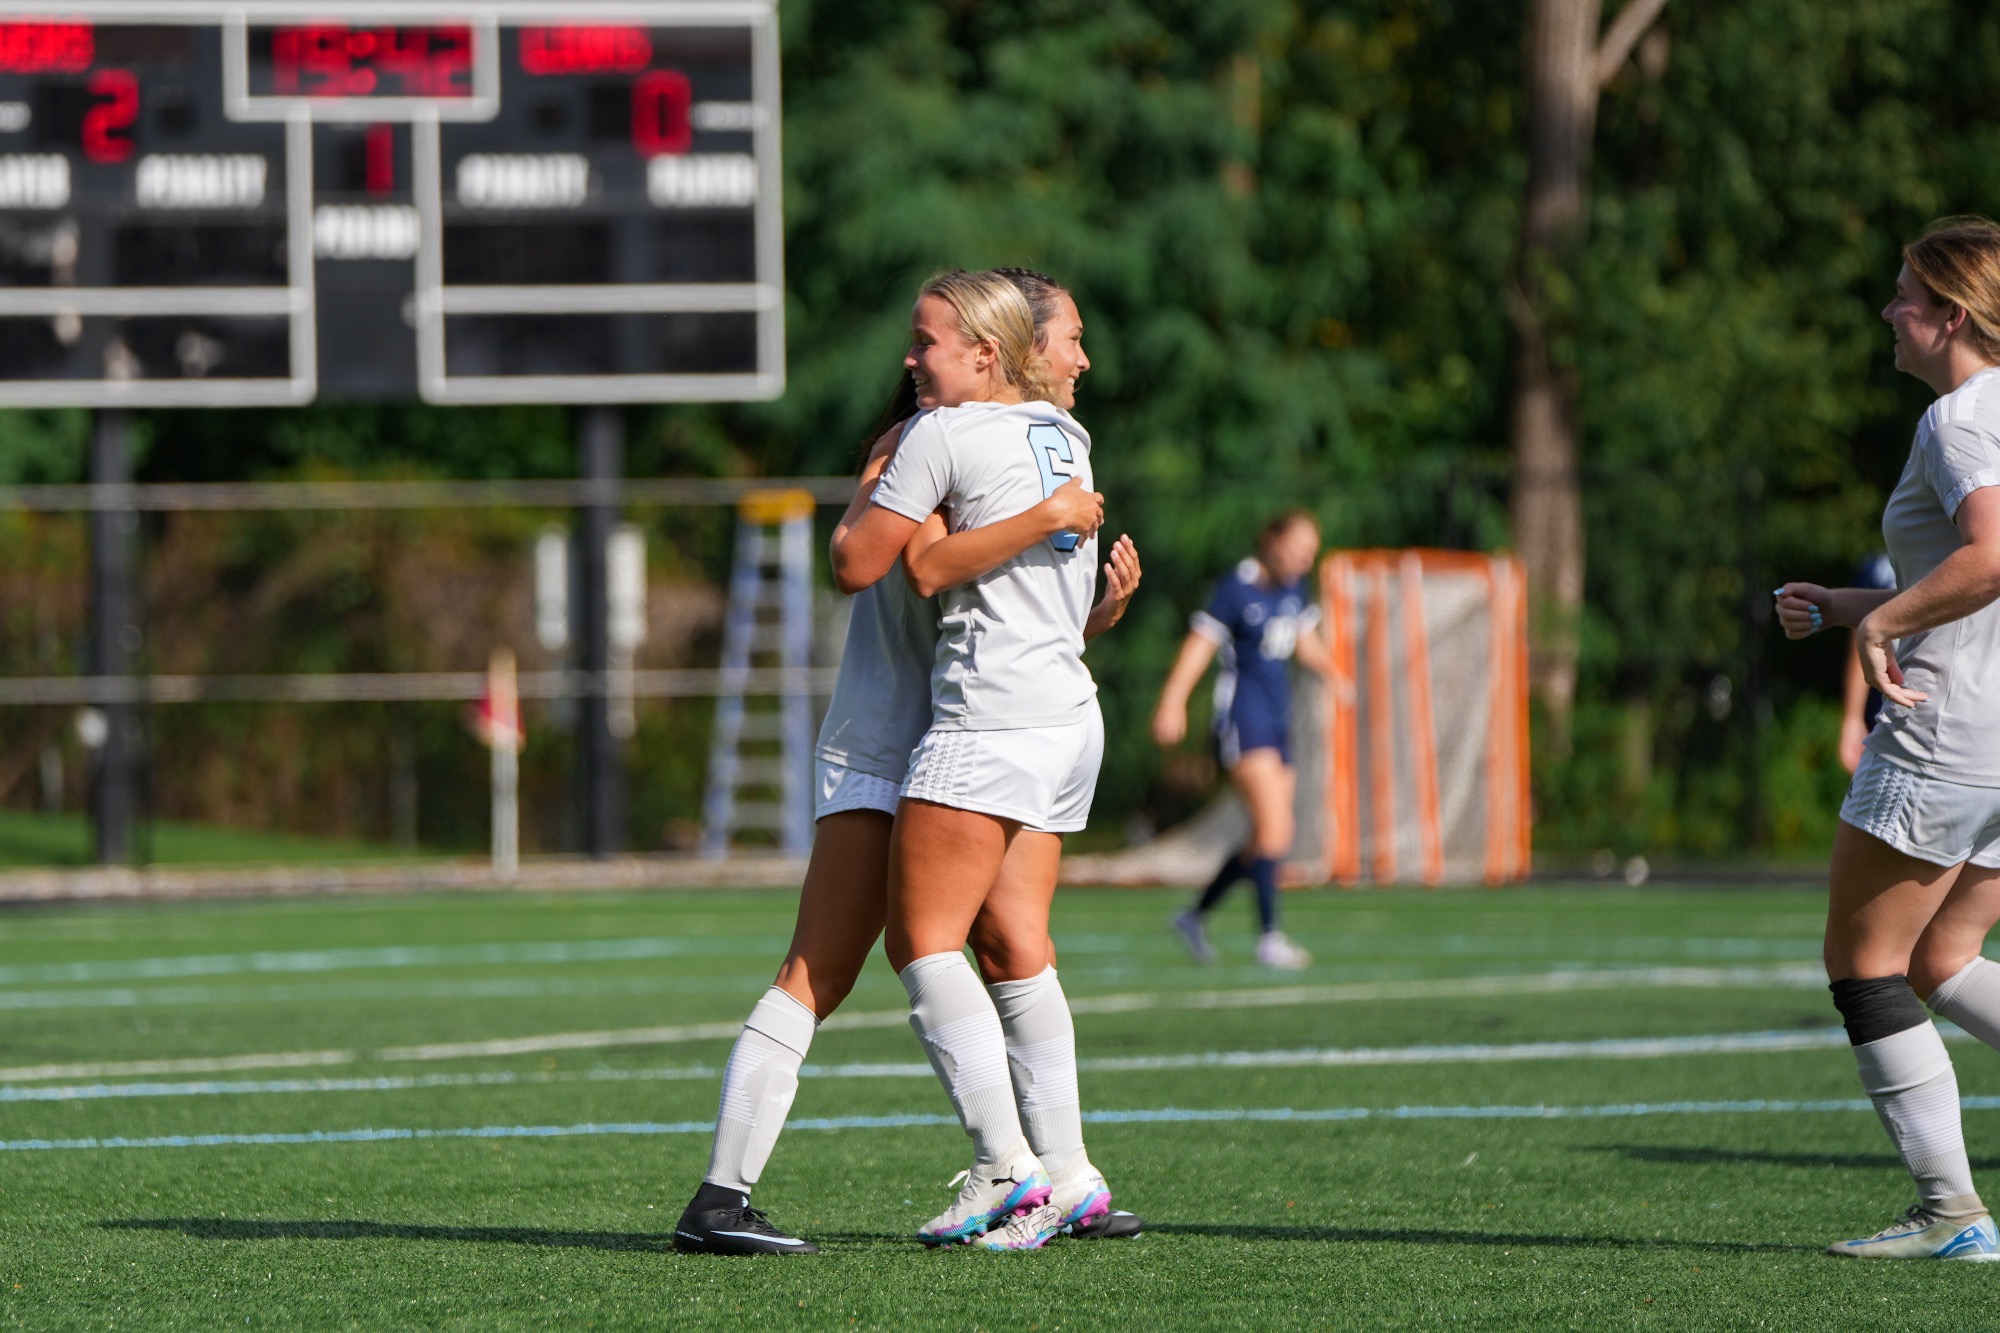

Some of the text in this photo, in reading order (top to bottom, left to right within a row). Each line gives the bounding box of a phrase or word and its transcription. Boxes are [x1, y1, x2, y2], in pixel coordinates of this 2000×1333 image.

[82, 68, 139, 163] 2
[632, 69, 692, 159] 0
[365, 122, 393, 197] 1
